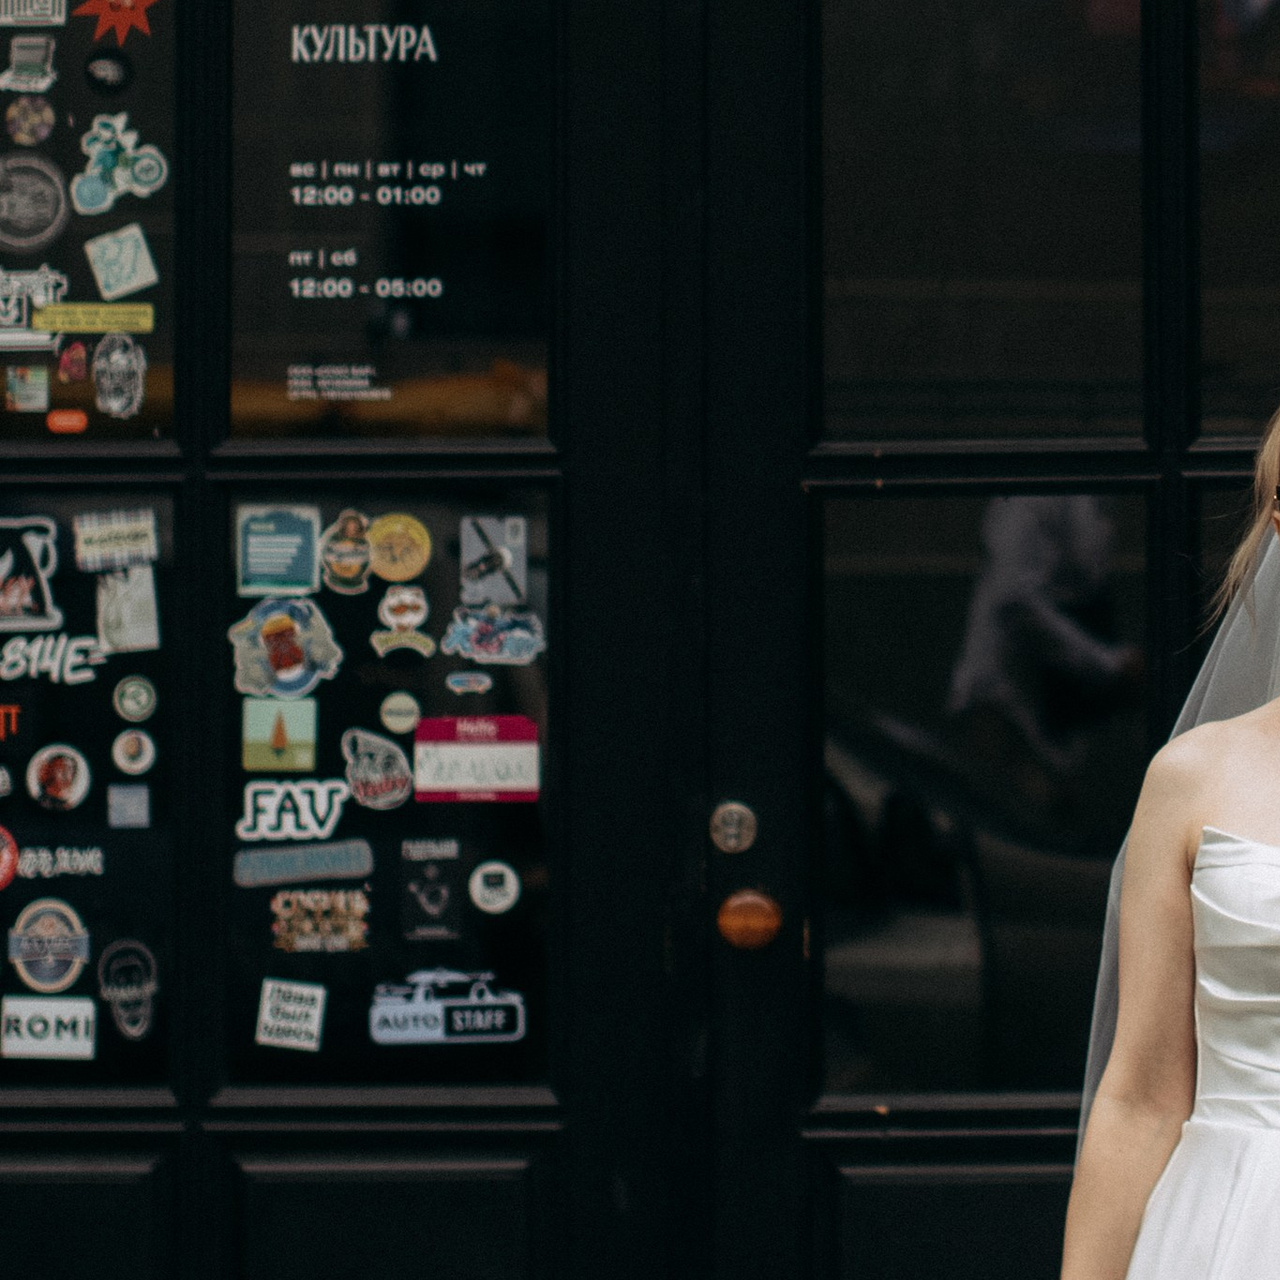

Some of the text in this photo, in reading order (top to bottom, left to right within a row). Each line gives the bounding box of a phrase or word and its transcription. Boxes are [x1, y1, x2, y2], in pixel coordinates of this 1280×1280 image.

[291, 24, 438, 62] КУЛЬТУРА
[333, 162, 361, 178] пн
[418, 162, 446, 179] ср
[463, 162, 487, 177] чт
[290, 185, 354, 205] 12:00
[376, 185, 441, 205] 01:00
[330, 248, 358, 267] сб
[289, 277, 353, 298] 12:00
[375, 277, 443, 298] 05:00
[240, 785, 345, 836] FAV
[5, 1014, 91, 1039] ROMI
[377, 1009, 508, 1032] AUTO STAFF
